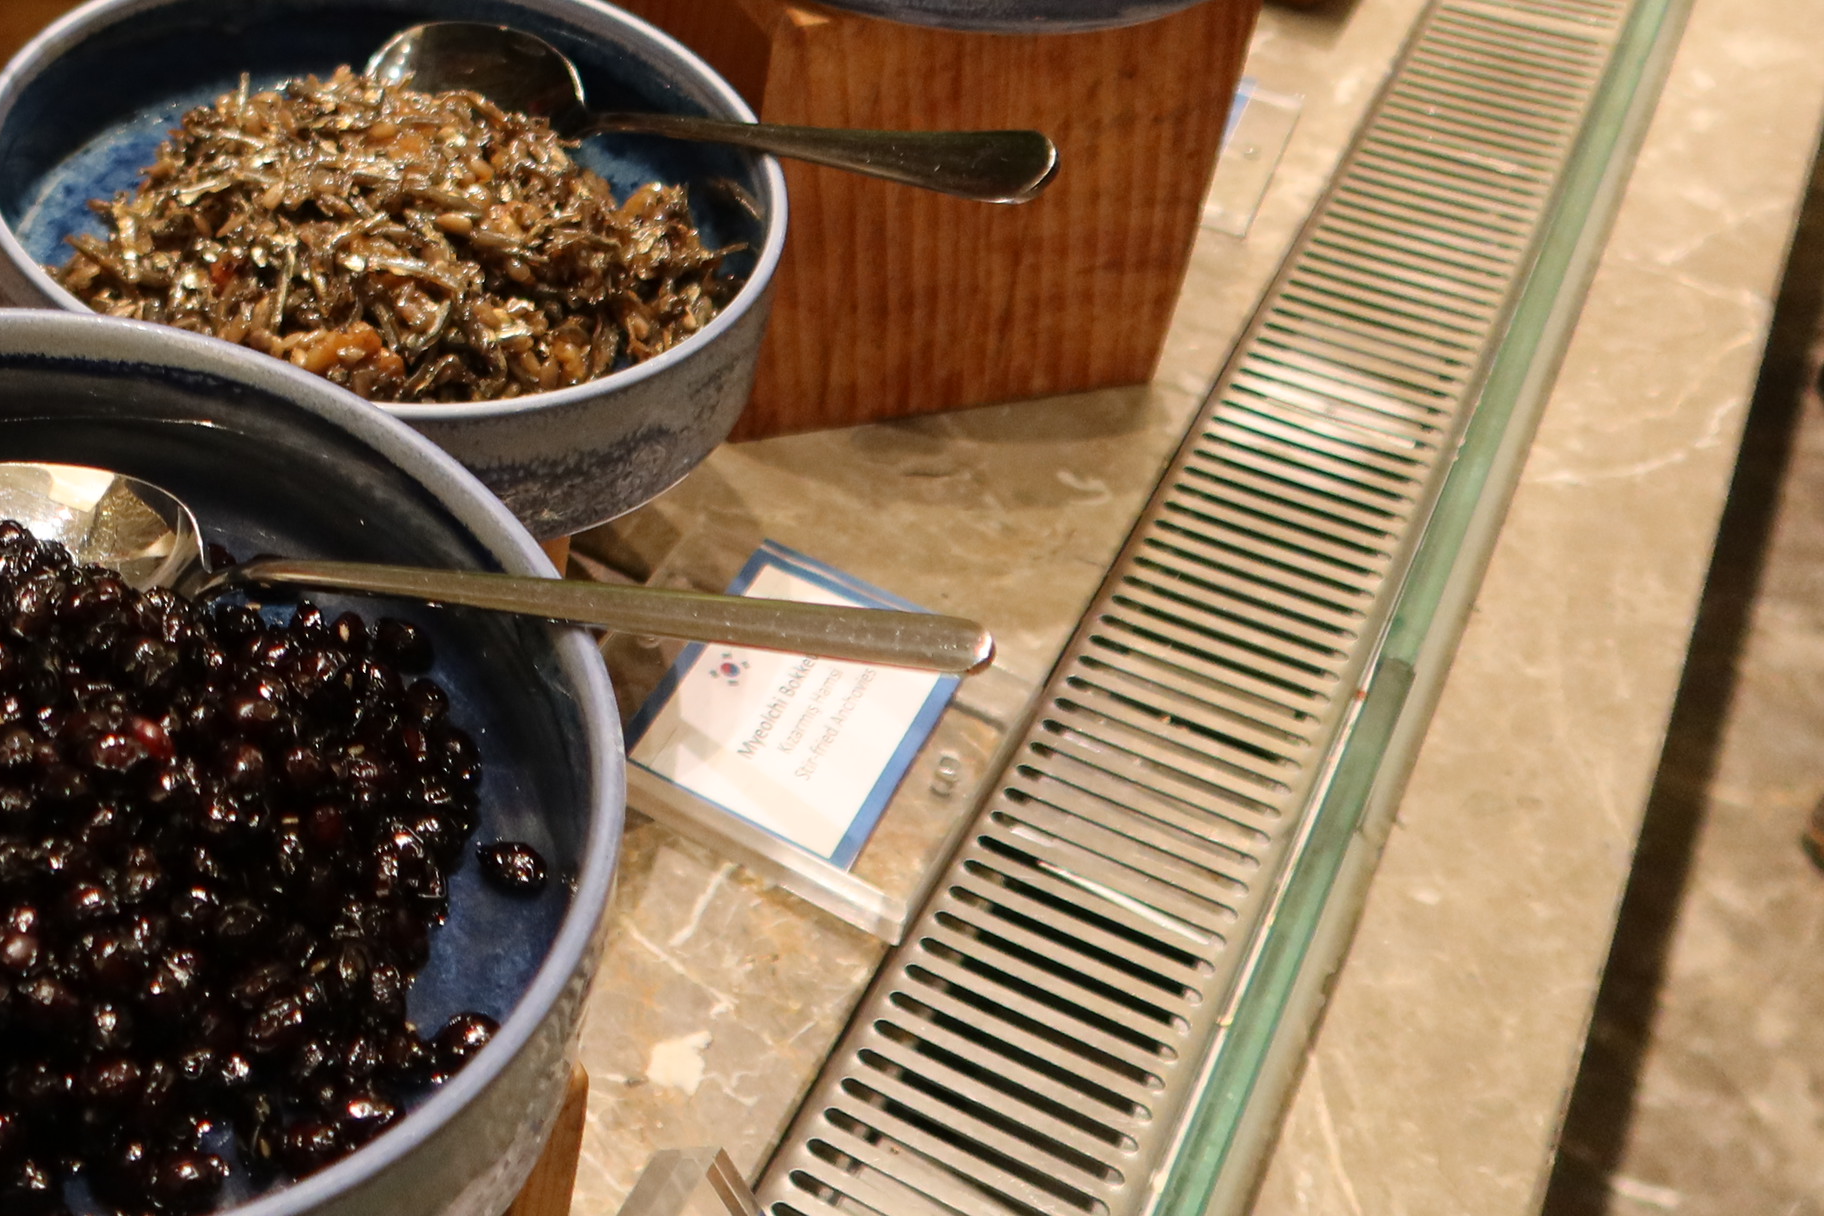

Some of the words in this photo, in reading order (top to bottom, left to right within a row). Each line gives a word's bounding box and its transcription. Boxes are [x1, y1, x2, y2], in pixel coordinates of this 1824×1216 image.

[736, 697, 787, 760] Myeolchi
[794, 724, 839, 781] Stir-fried
[830, 667, 877, 726] Anchovies
